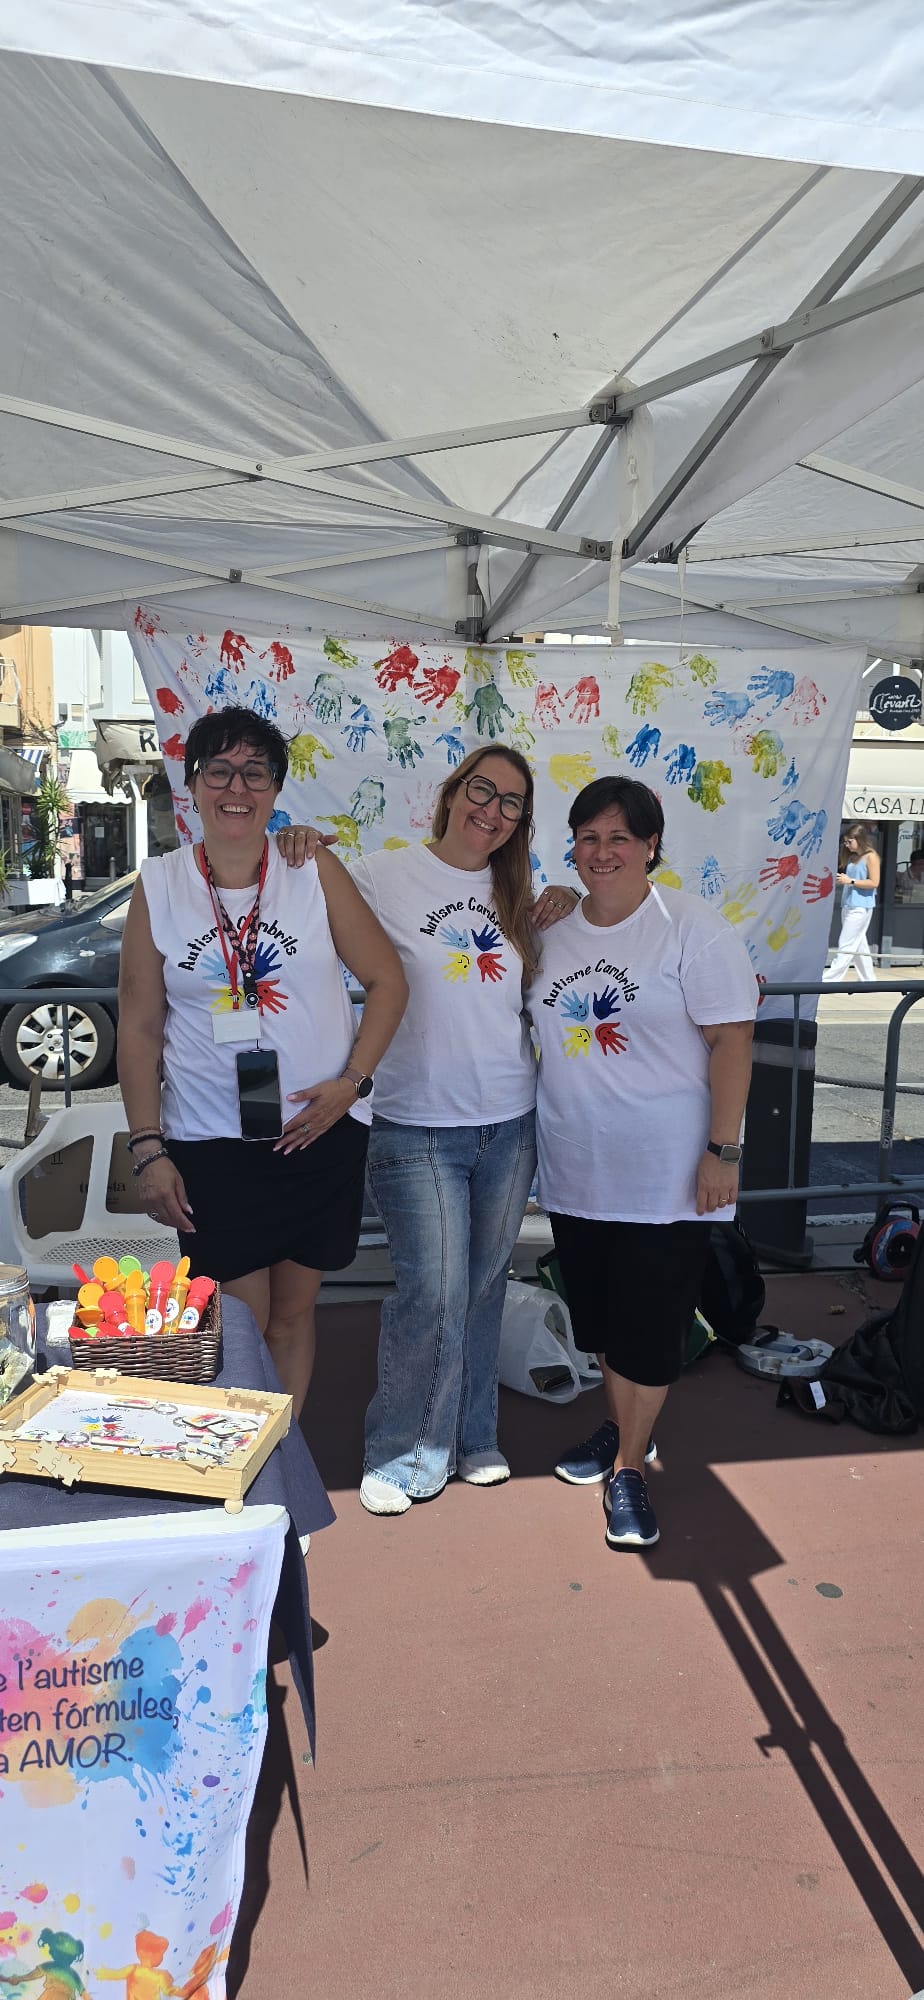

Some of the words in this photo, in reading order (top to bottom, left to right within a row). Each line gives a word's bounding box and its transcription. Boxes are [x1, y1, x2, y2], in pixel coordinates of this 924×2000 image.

[139, 729, 162, 753] R
[853, 796, 903, 814] CASA
[419, 901, 465, 937] Autisme
[177, 923, 229, 972] Autism
[236, 915, 299, 956] Cmbrils
[542, 966, 592, 1008] Autisme
[594, 958, 640, 1003] Cambrils
[18, 1657, 145, 1691] l'autisme
[52, 1687, 179, 1731] fórmules,
[19, 1732, 134, 1773] AMOR.
